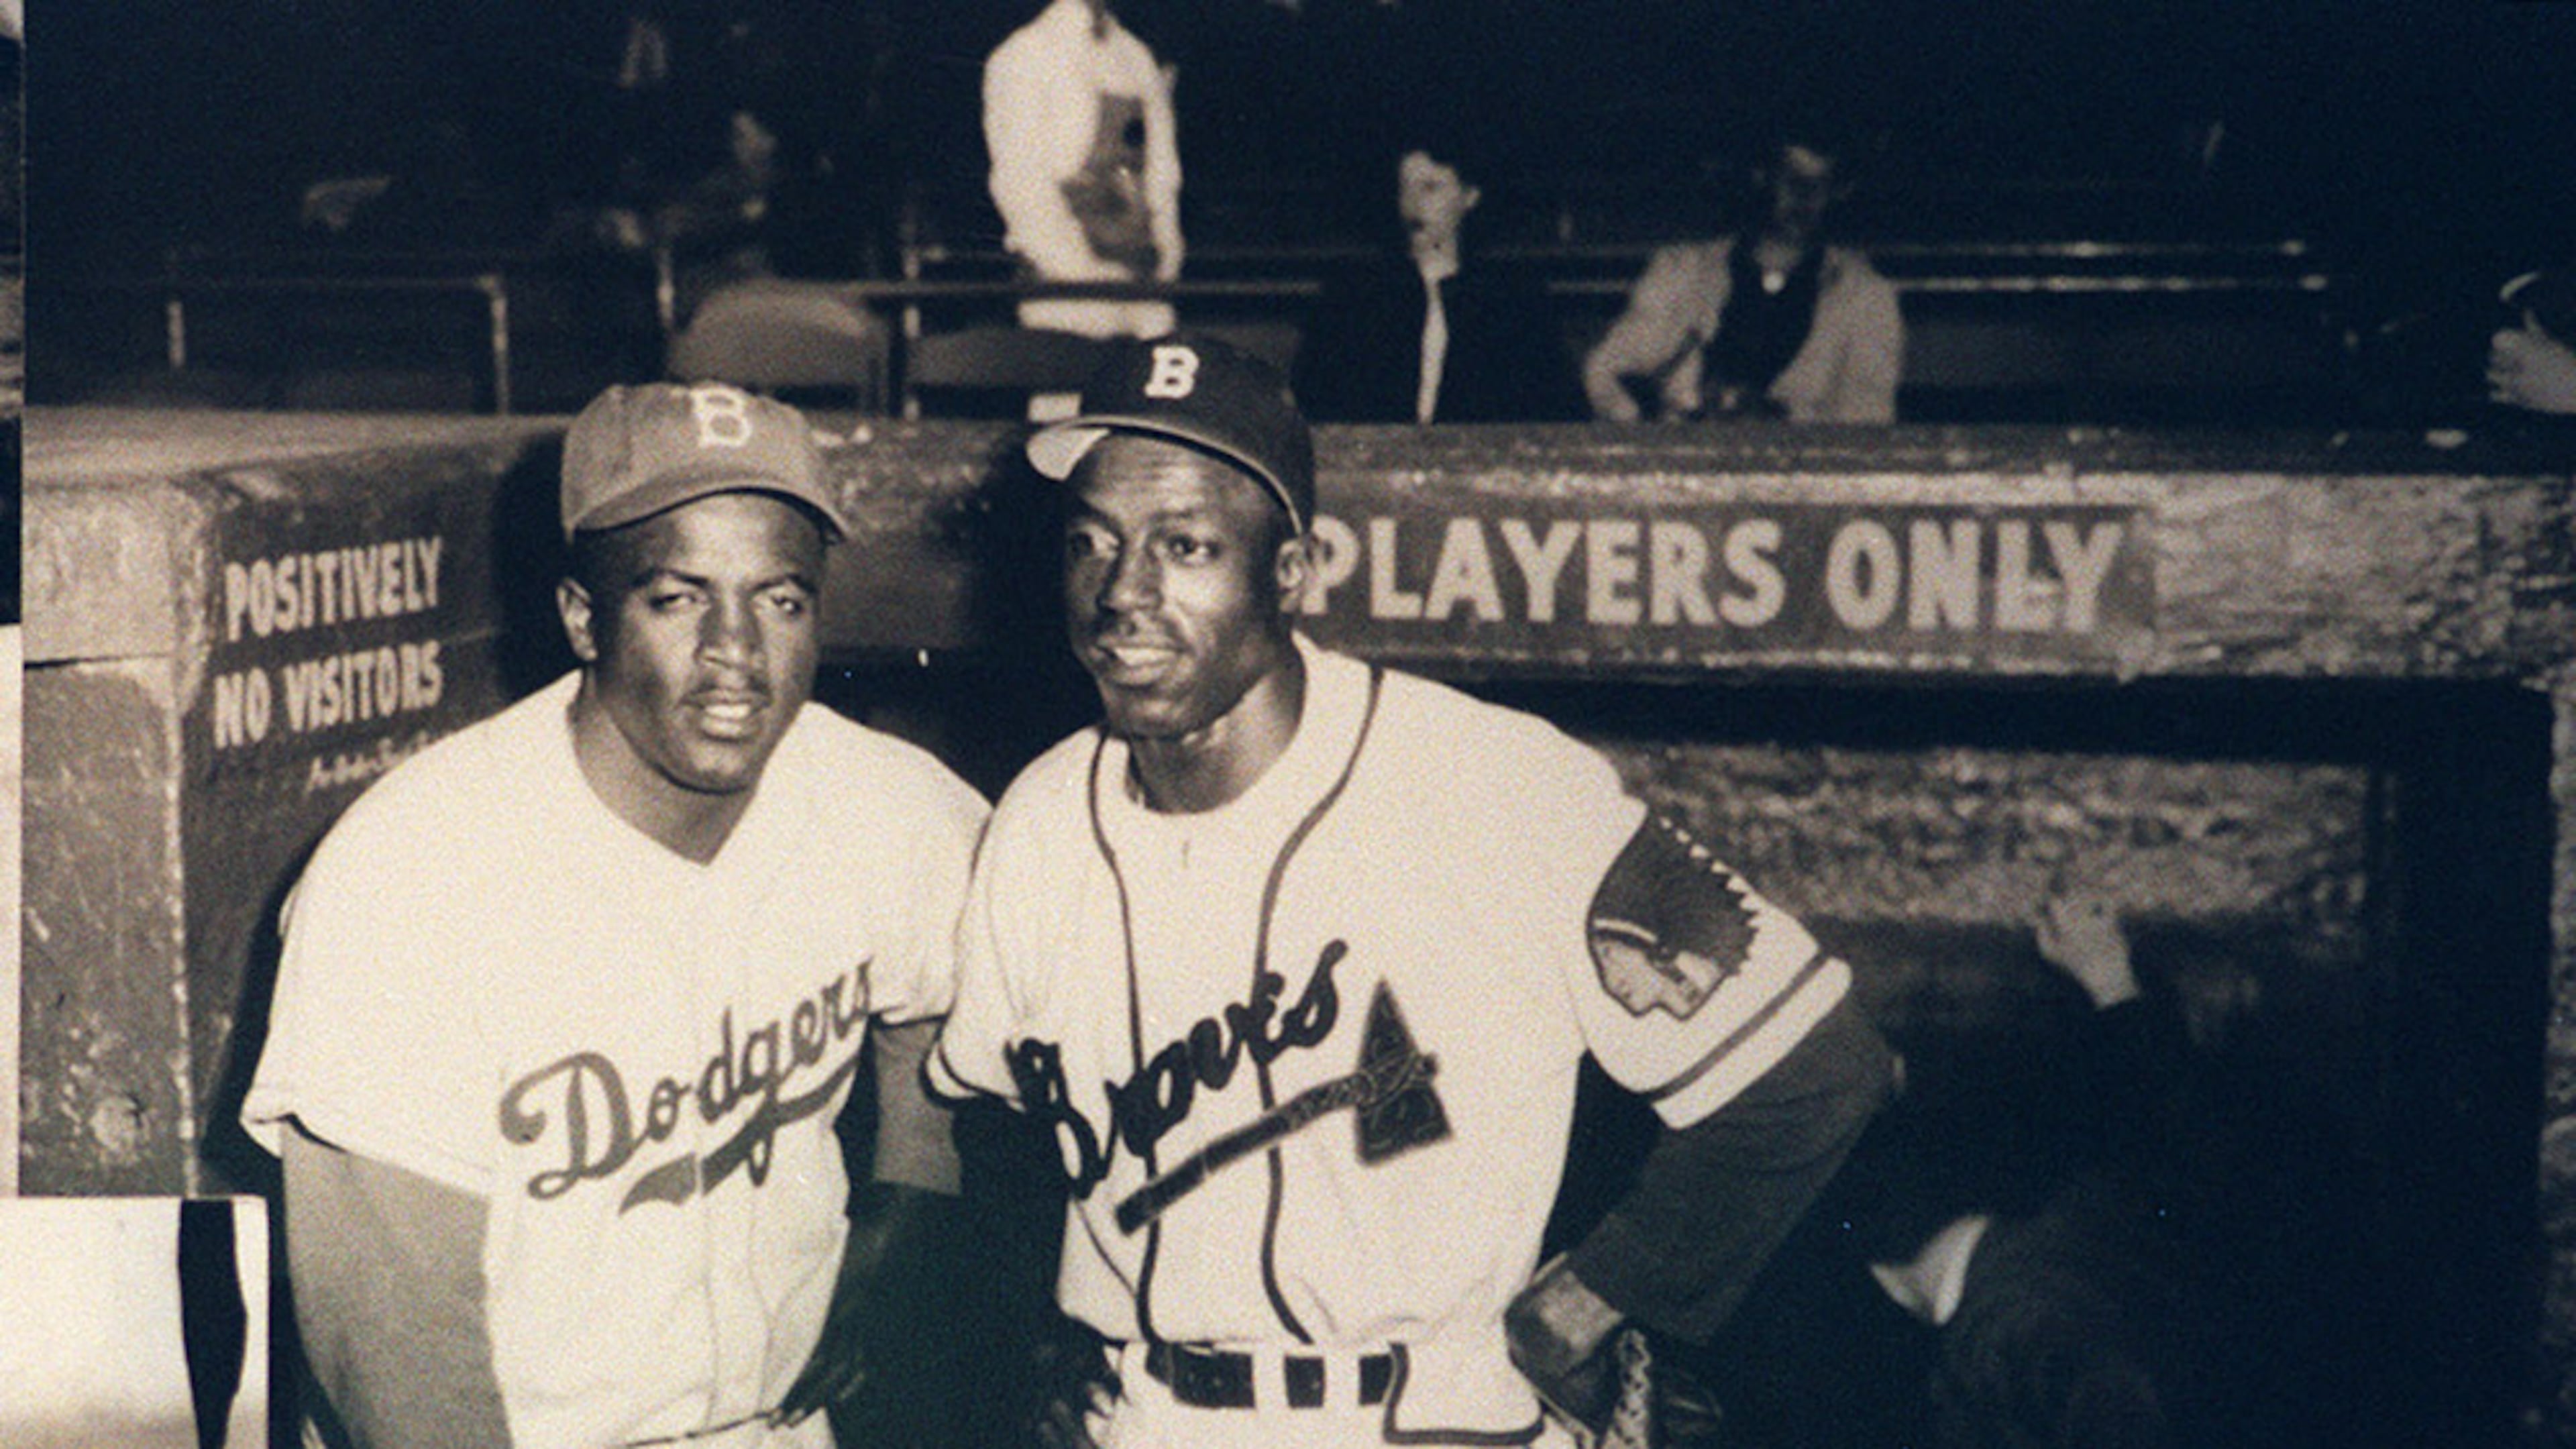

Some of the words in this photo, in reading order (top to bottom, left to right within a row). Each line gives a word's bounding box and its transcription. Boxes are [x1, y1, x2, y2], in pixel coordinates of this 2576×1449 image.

[690, 384, 752, 449] B
[1144, 345, 1199, 398] B
[225, 535, 443, 642] POSITIVELY
[1299, 515, 1785, 628] PLAYERS
[1825, 518, 2125, 632] ONLY
[214, 666, 271, 750] NO
[284, 639, 444, 733] VISITORS
[498, 955, 873, 1200] Dodgers
[1002, 938, 1348, 1201] Braves
